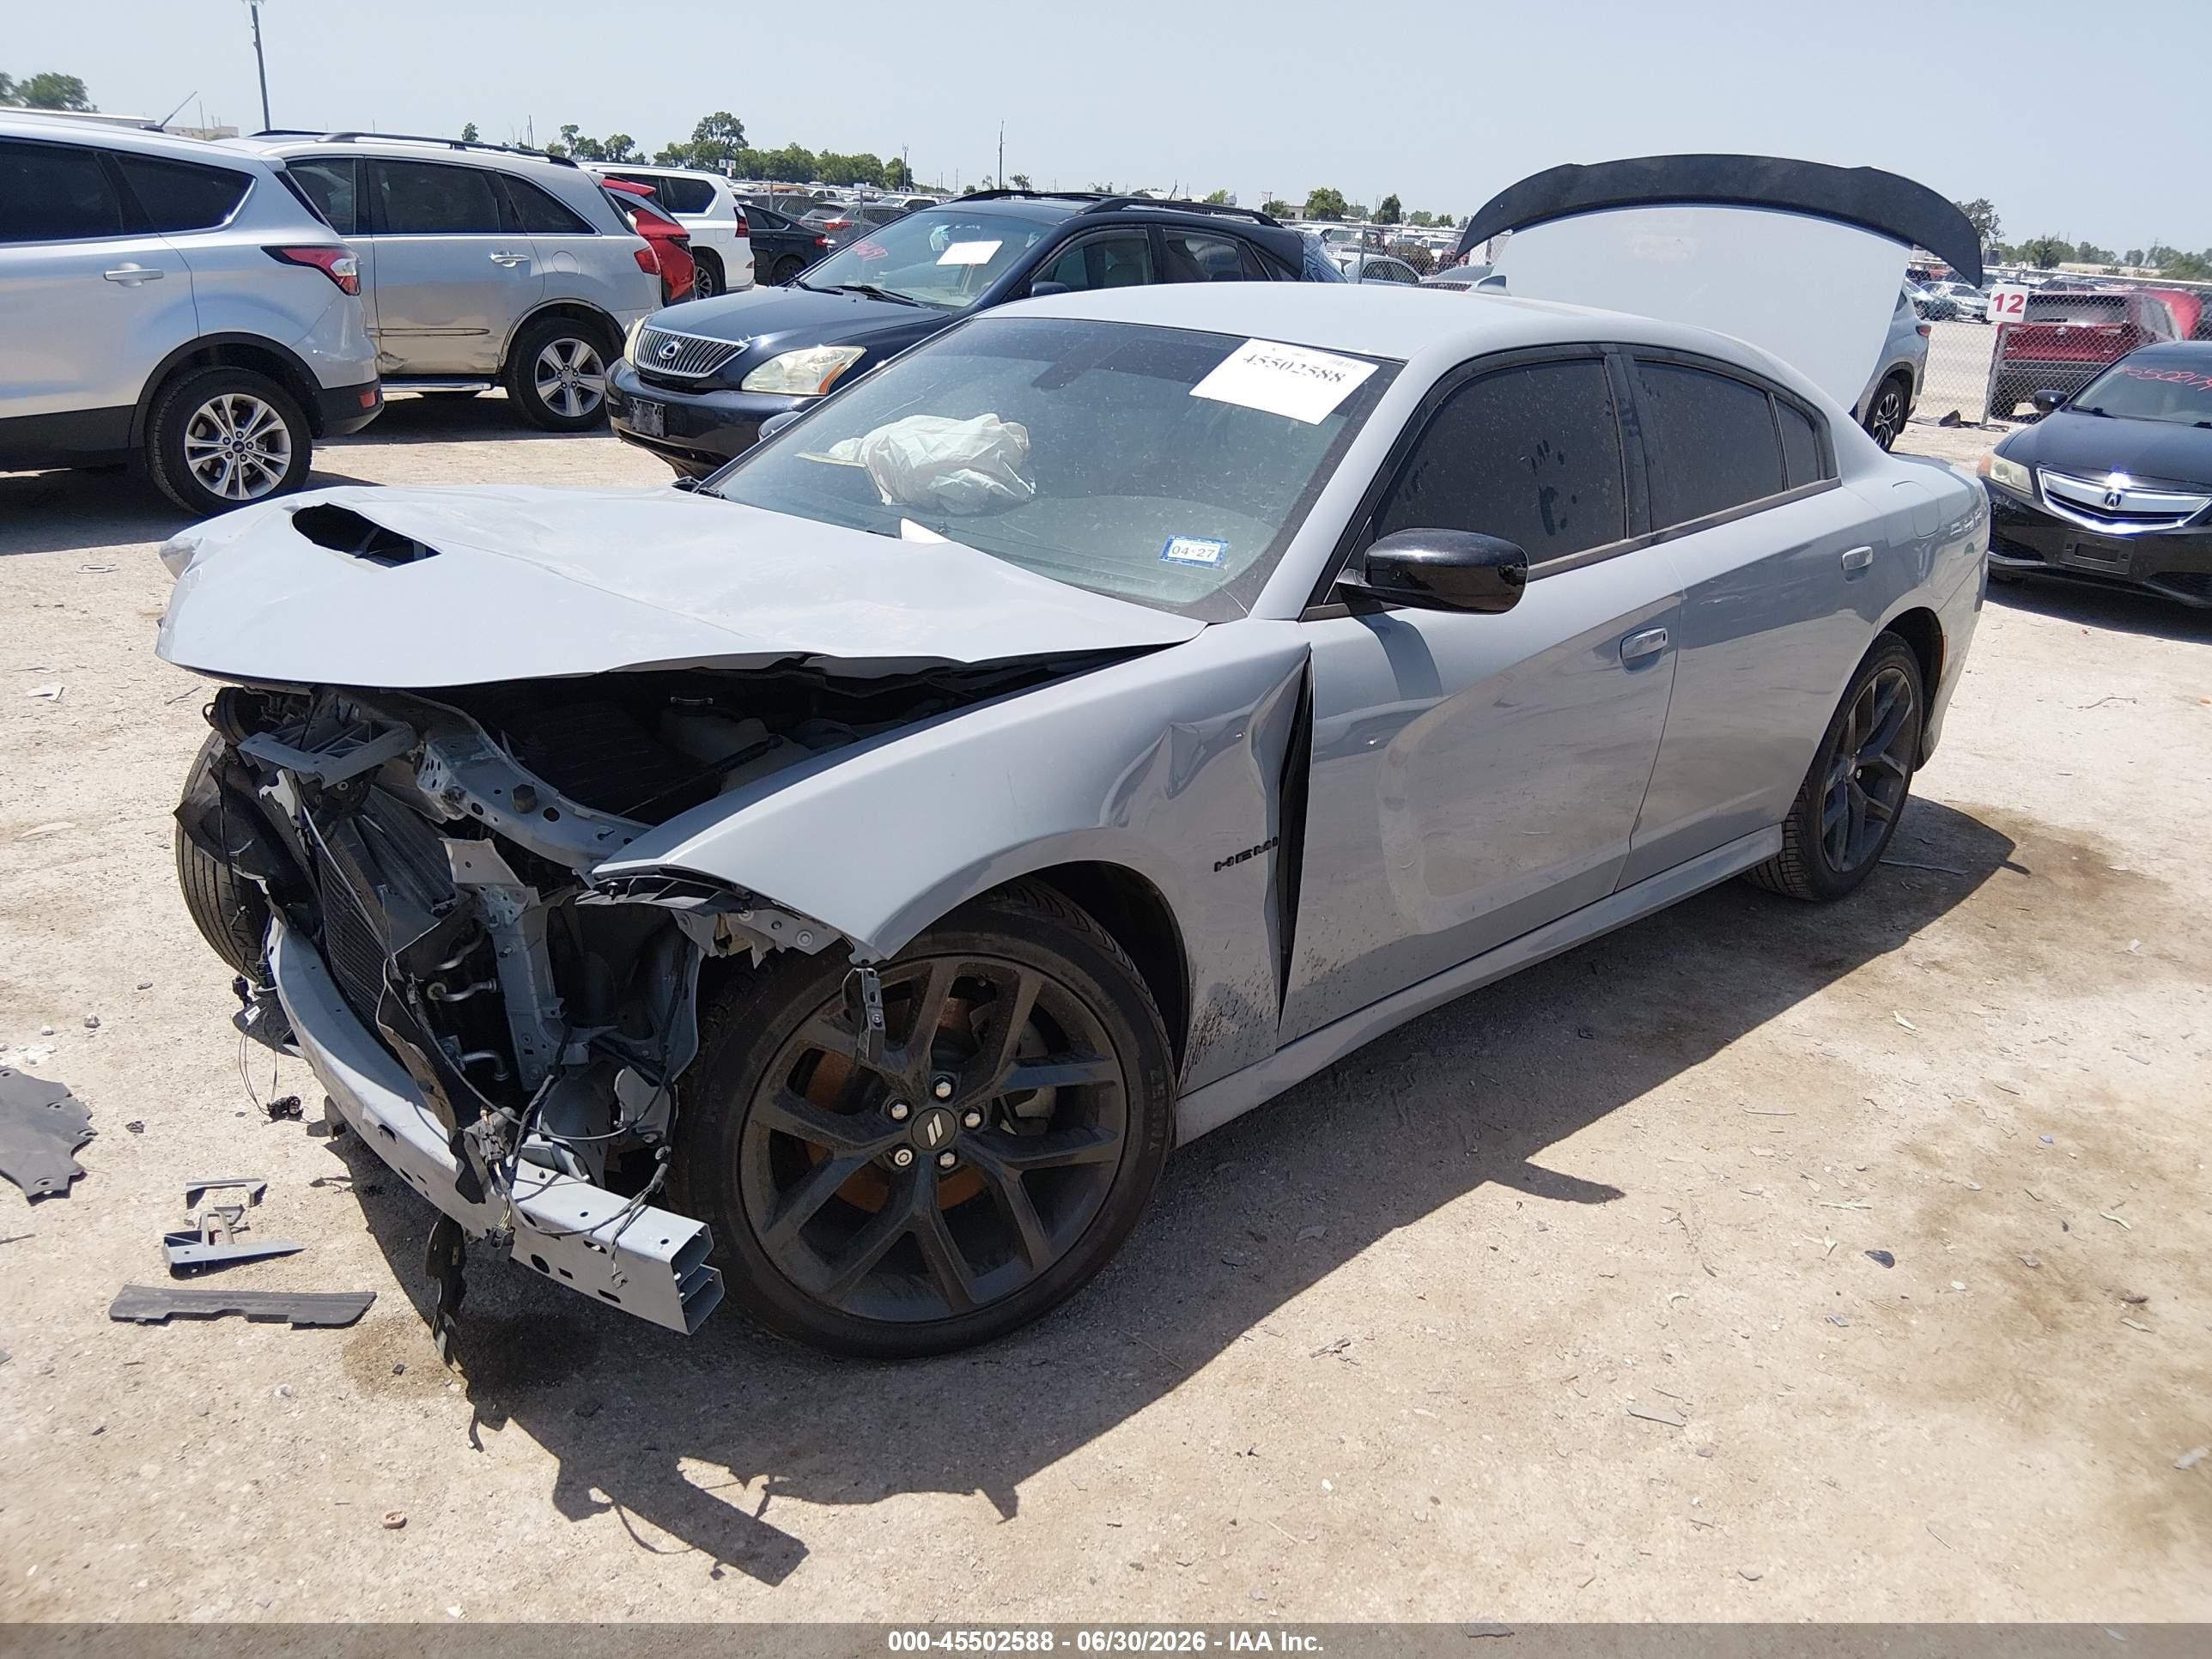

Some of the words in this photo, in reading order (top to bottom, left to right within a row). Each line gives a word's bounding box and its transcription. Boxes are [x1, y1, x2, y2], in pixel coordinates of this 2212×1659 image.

[1992, 293, 2025, 313] 12
[1243, 354, 1346, 383] 45502588
[1213, 836, 1279, 872] HEMI
